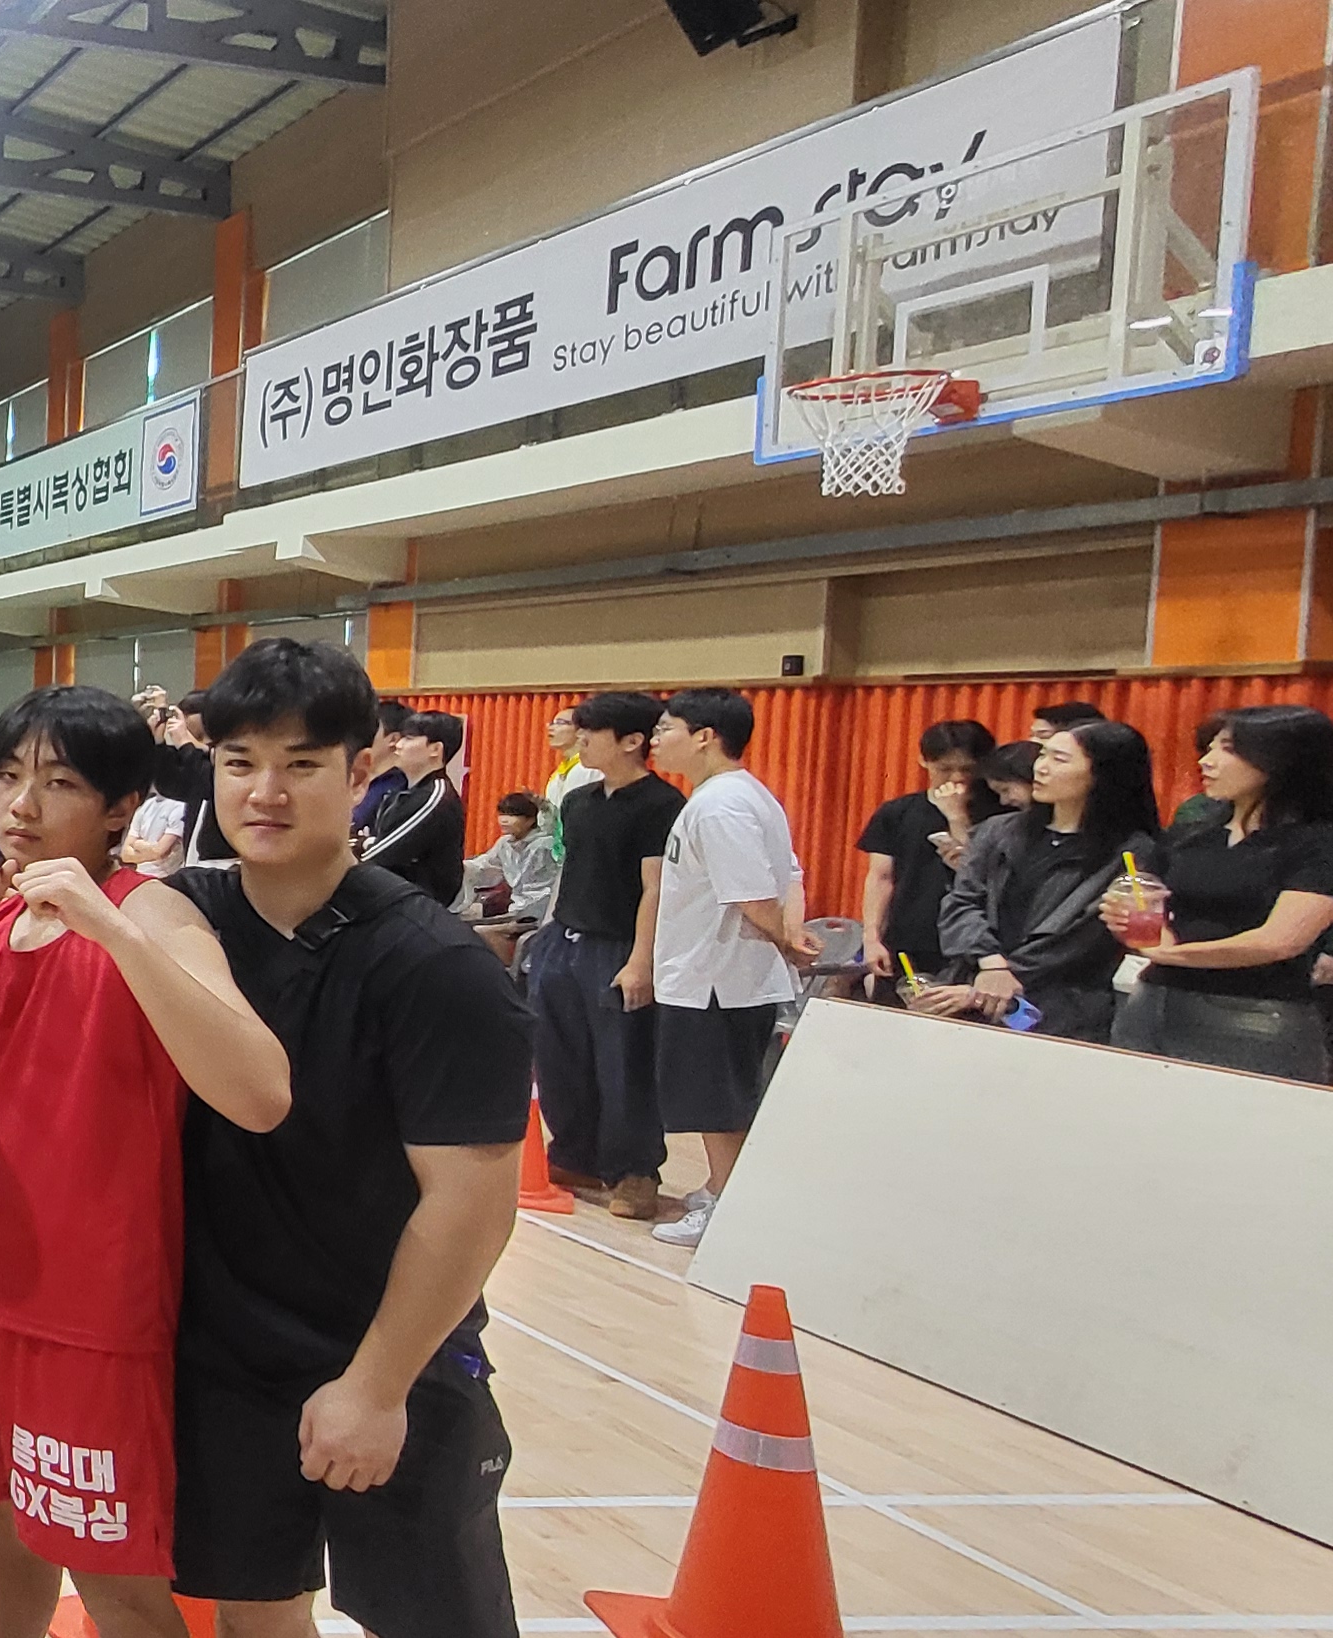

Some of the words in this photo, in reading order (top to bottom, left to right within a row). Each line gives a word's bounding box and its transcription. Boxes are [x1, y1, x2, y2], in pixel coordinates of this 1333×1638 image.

[606, 206, 785, 315] Farm
[552, 331, 614, 373] Stay
[623, 279, 771, 354] beautiful
[785, 257, 840, 304] wit
[11, 1422, 117, 1494] 용인대
[9, 1467, 129, 1542] GX복싱
